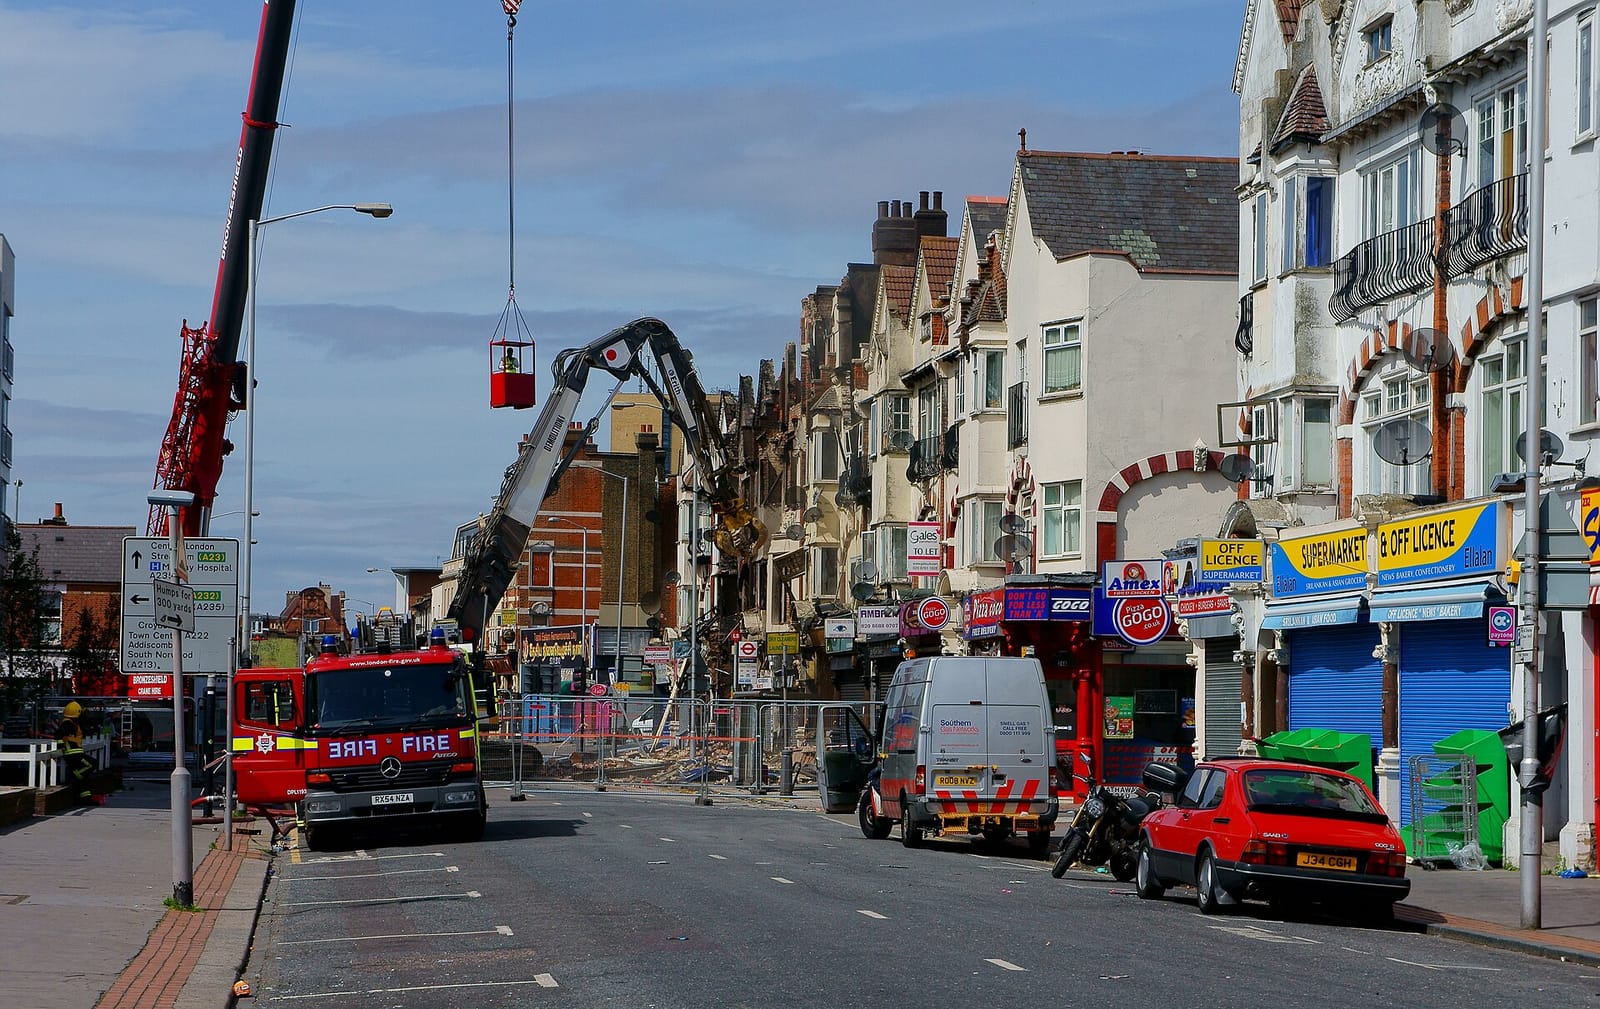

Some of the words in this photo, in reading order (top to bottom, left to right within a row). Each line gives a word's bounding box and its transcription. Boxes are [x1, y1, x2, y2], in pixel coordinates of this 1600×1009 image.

[220, 147, 243, 260] BRONZESHIELD
[670, 376, 682, 395] Erith
[910, 530, 938, 543] Gales
[1380, 531, 1387, 557] &
[1390, 527, 1410, 556] OFF
[1412, 519, 1456, 553] LICENCE
[185, 542, 215, 550] London
[913, 547, 923, 555] TO
[925, 547, 938, 555] LET
[1219, 543, 1245, 554] OFF
[198, 553, 226, 561] (A23)
[1301, 535, 1366, 569] SUPERMARKET
[1464, 545, 1492, 569] Ellalan
[1206, 555, 1258, 565] LICENCE
[197, 563, 233, 573] Hospital
[1381, 572, 1395, 581] NEWS
[1414, 564, 1456, 576] CONFECTIONERY
[1203, 571, 1260, 580] SUPERMARKET
[1108, 577, 1160, 590] Amex
[1276, 575, 1297, 593] Ellalan
[156, 584, 179, 598] Humps
[181, 590, 191, 600] for
[1008, 592, 1033, 601] DON'T
[1035, 592, 1046, 600] GO
[157, 597, 172, 609] 300
[173, 601, 192, 613] yards
[973, 598, 988, 620] Pizza
[1008, 601, 1024, 609] FOR
[1026, 601, 1046, 609] LESS
[1052, 600, 1090, 610] GOGO
[1126, 604, 1145, 614] Pizza
[923, 608, 946, 619] GOGO
[1009, 610, 1032, 618] THAN
[1122, 606, 1162, 628] GOGO
[1323, 612, 1337, 623] FOOD
[1387, 609, 1397, 619] OFF
[1397, 608, 1418, 619] LICENCE
[1422, 607, 1436, 618] NEWS
[1439, 605, 1462, 617] BAKERY
[184, 632, 210, 640] A222
[971, 626, 981, 636] FREE
[981, 625, 997, 636] DELIVERY
[128, 641, 173, 649] Addiscomb
[127, 651, 152, 659] South
[349, 657, 421, 667] www.london-fire.gov.uk
[133, 675, 168, 684] BRONZESHIELD
[137, 687, 151, 695] CRANE
[940, 719, 972, 727] Southern
[402, 735, 450, 753] FIRE
[375, 794, 395, 804] RX54
[396, 793, 410, 803] NZA
[1302, 855, 1325, 865] J34
[1327, 857, 1352, 868] CGH
